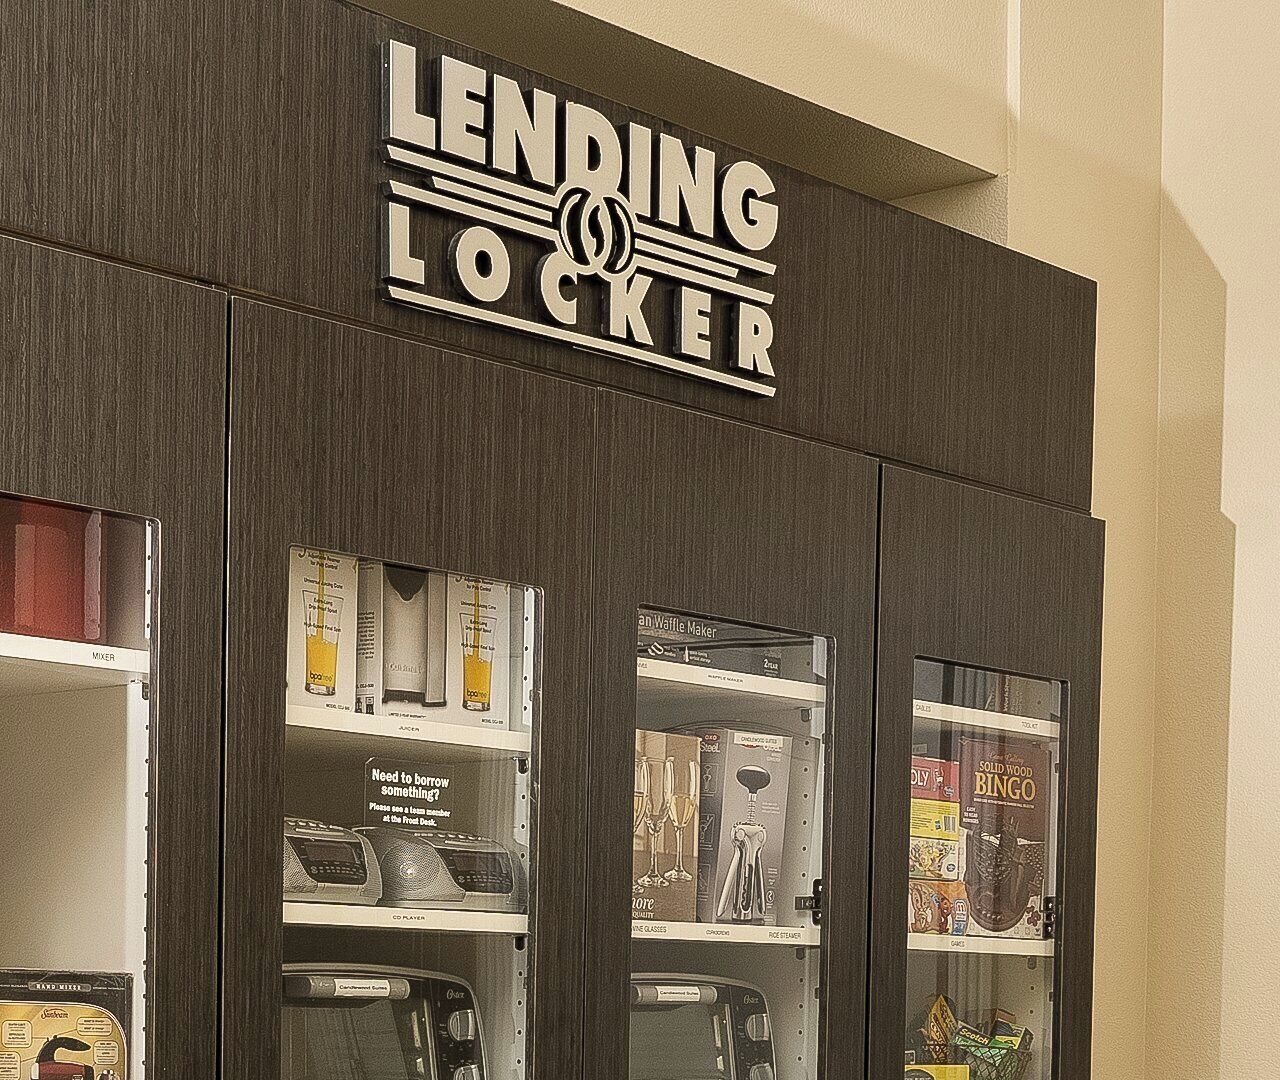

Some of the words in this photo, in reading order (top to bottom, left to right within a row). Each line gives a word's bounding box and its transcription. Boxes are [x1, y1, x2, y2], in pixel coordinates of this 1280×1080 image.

[388, 39, 779, 251] LENDING
[388, 201, 776, 377] LOCKER
[654, 614, 685, 632] Waffle
[687, 620, 717, 638] Maker
[92, 652, 116, 662] MIXER
[372, 768, 399, 783] Need
[400, 771, 412, 785] to
[414, 772, 450, 788] borrow
[980, 760, 1004, 774] SOLID
[1006, 764, 1033, 778] WOOD
[380, 785, 440, 803] something?
[974, 771, 1036, 801] BINGO
[369, 802, 390, 812] Please
[404, 806, 409, 814] a
[410, 806, 426, 814] team
[426, 808, 451, 818] member
[382, 814, 390, 822] at
[390, 815, 402, 824] the
[402, 816, 420, 825] Front
[420, 818, 438, 826] Desk.
[960, 1028, 989, 1045] Scotch
